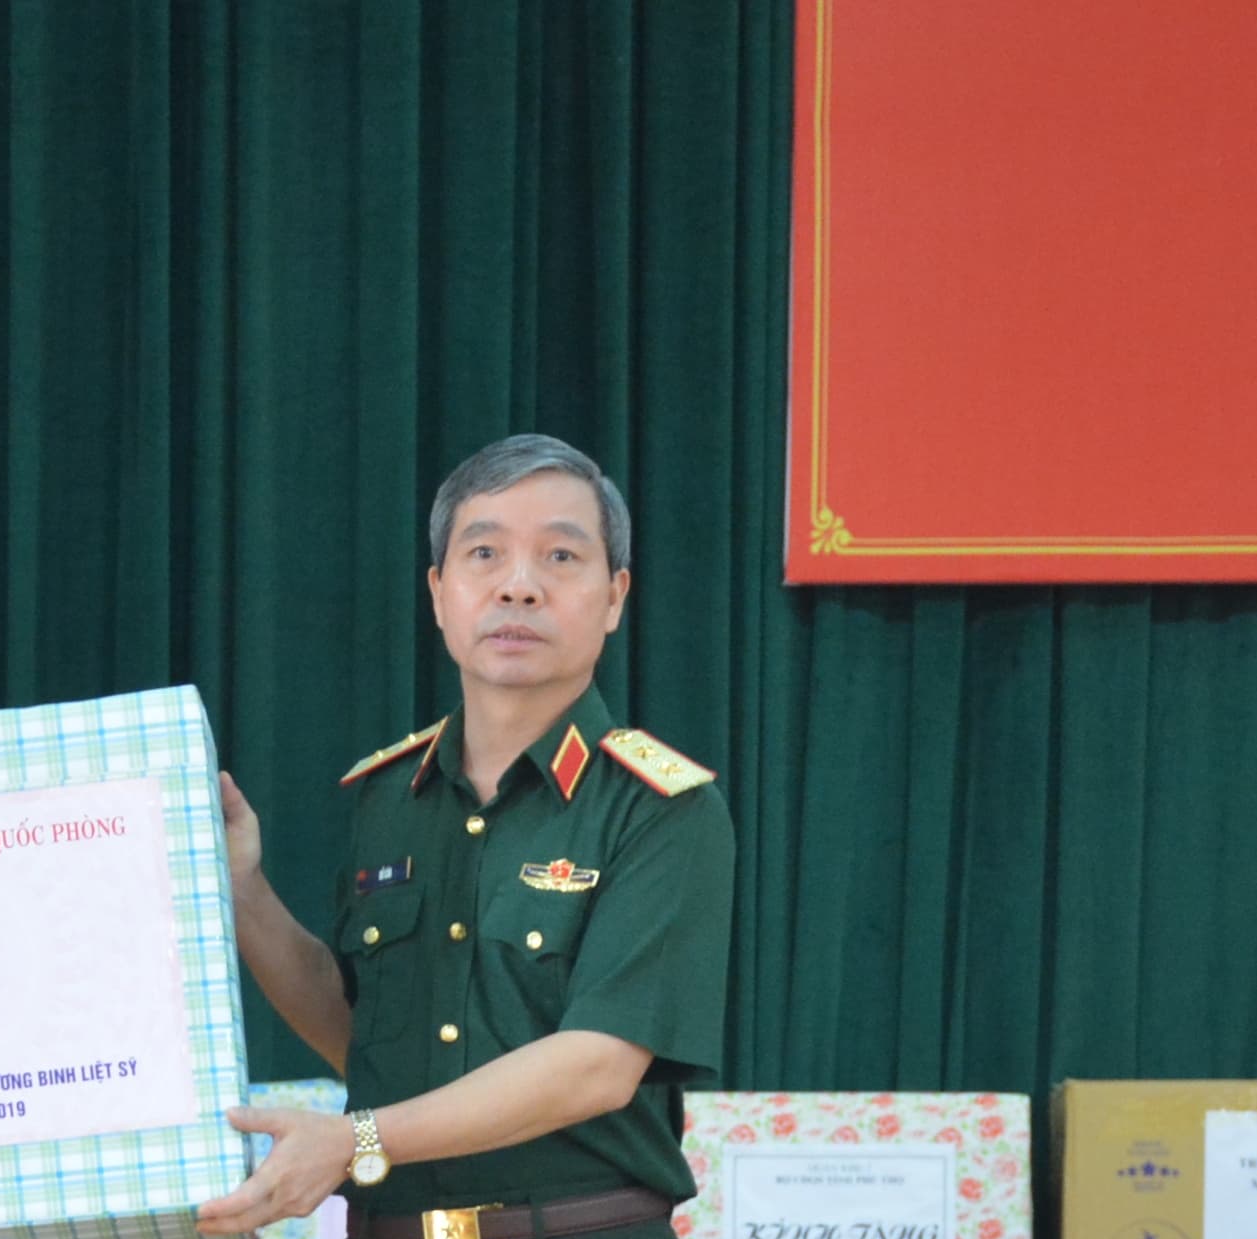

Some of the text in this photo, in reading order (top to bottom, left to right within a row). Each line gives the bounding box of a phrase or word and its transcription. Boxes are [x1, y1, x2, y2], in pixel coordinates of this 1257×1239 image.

[52, 813, 126, 843] PHÒNG
[38, 1066, 77, 1087] BINH
[81, 1059, 113, 1084] LIỆT
